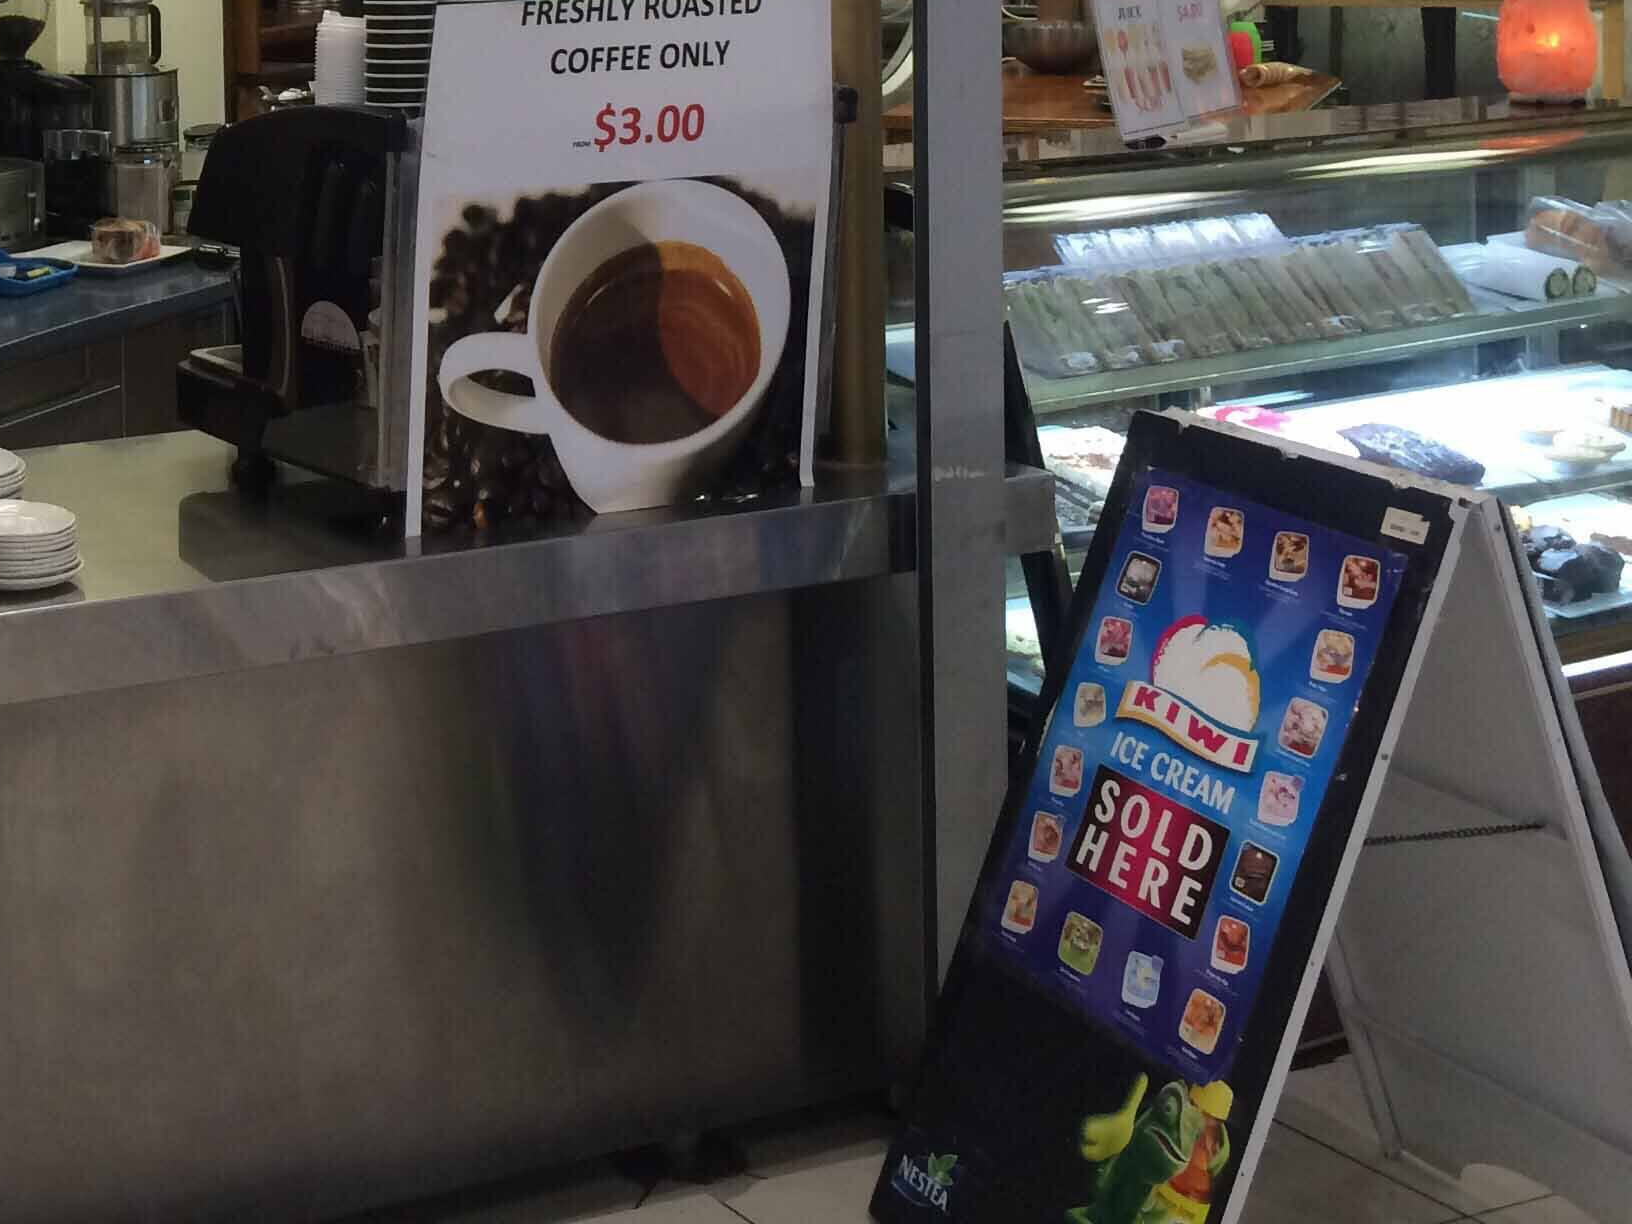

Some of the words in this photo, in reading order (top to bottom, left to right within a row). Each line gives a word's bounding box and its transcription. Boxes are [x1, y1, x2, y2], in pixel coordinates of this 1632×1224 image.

[1118, 5, 1142, 21] JUICE
[550, 44, 652, 75] COFFEE
[659, 40, 731, 69] ONLY
[572, 139, 591, 148] FROM
[593, 102, 705, 153] $3.00
[1131, 685, 1253, 767] KIWI
[1110, 730, 1143, 772] ICE
[1150, 748, 1236, 816] CREAM
[1093, 778, 1215, 873] SOLD
[1075, 822, 1206, 927] HERE
[898, 1153, 949, 1212] NESTEA
